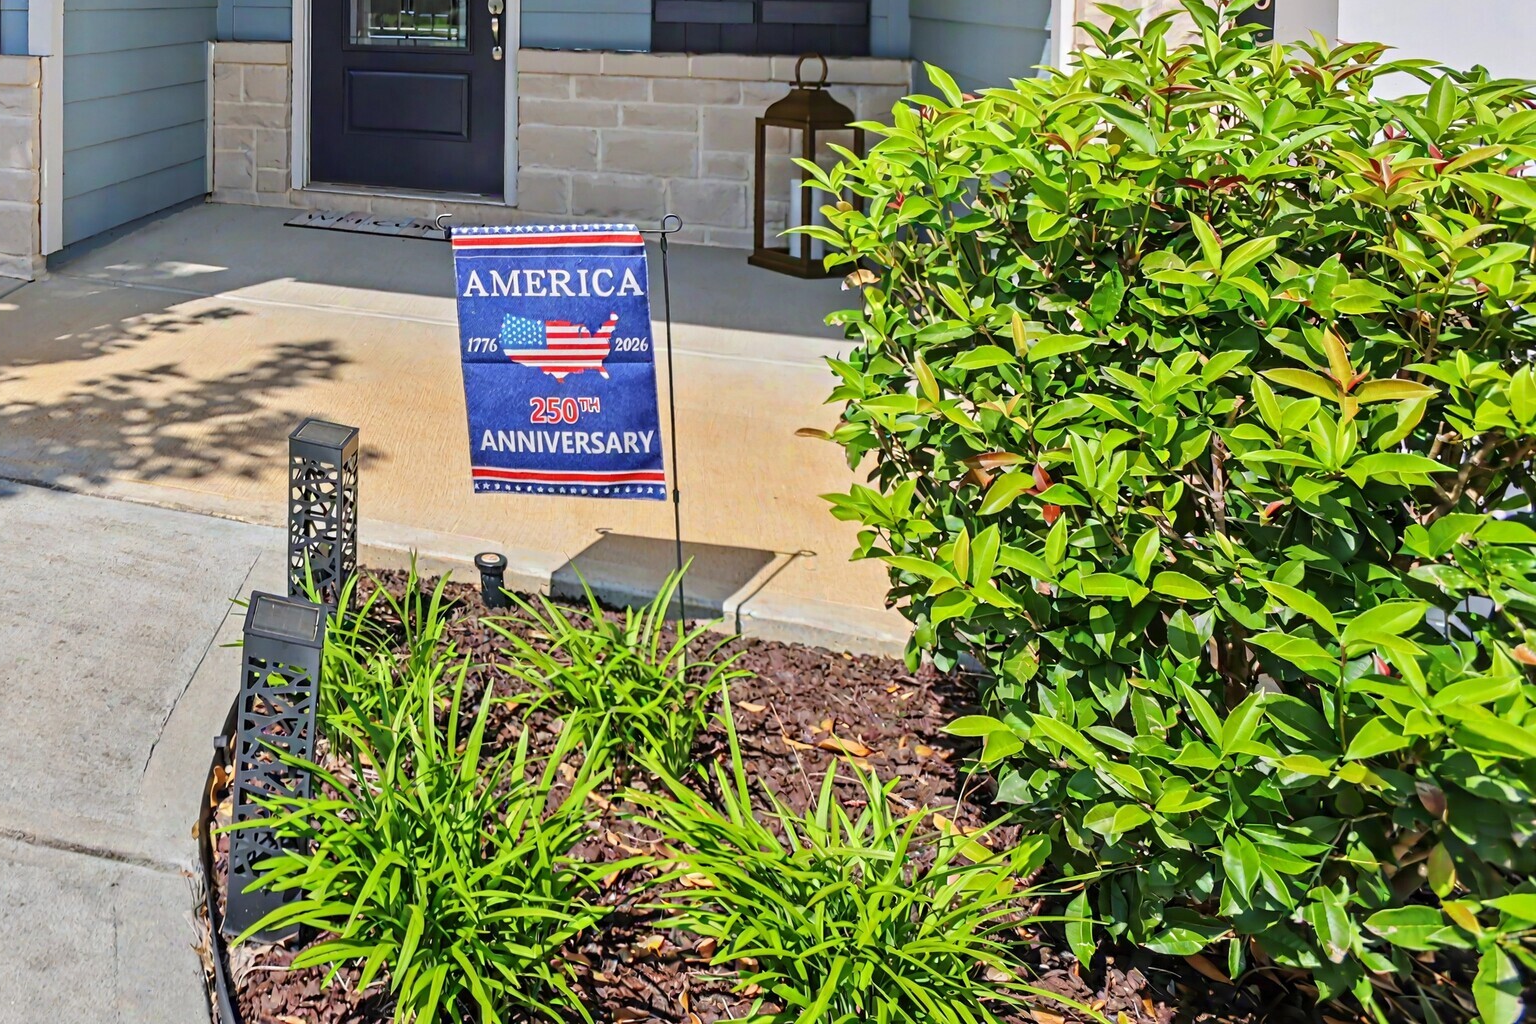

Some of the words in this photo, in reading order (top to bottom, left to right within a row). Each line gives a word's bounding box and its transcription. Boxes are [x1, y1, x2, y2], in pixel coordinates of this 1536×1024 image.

[463, 268, 644, 297] AMERICA
[467, 337, 498, 353] 1776
[615, 336, 648, 352] 2026
[529, 397, 600, 424] 250TH
[480, 429, 654, 454] ANNIVERSARY
